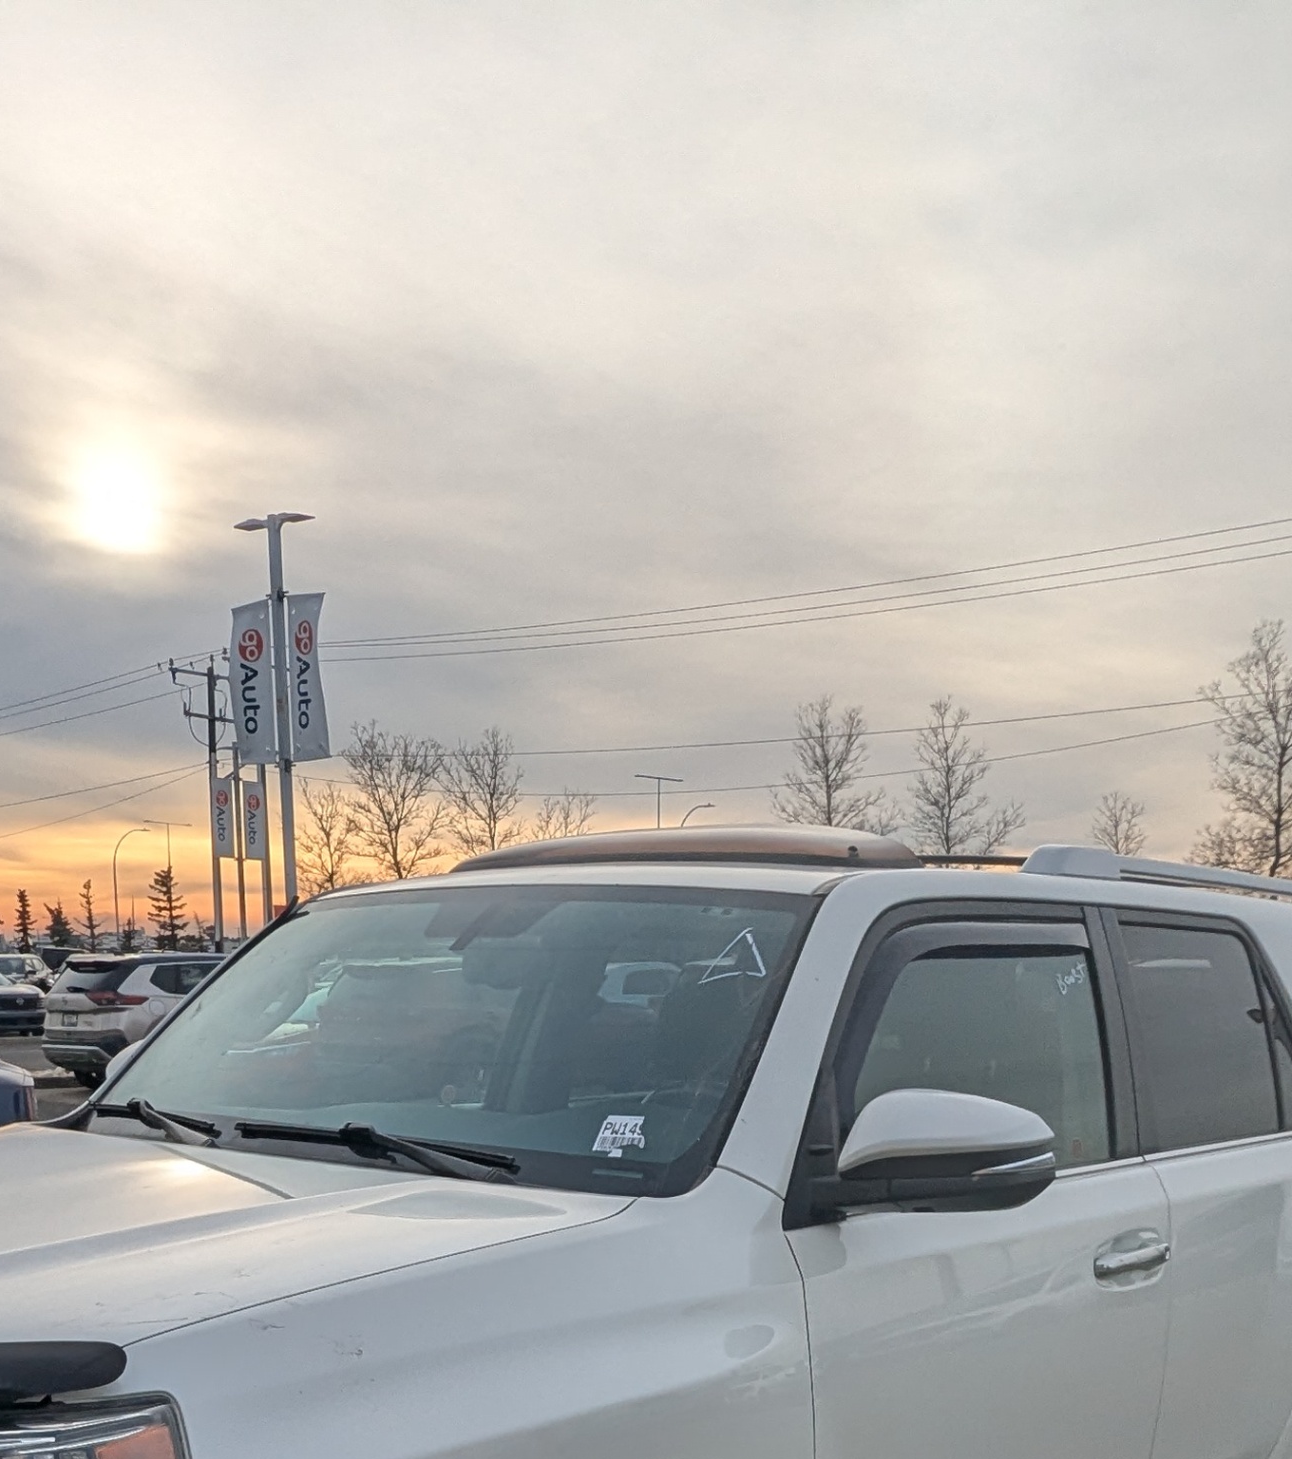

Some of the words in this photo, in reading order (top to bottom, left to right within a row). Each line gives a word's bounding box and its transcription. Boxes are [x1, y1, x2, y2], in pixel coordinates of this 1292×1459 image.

[240, 663, 260, 734] Auto
[296, 656, 311, 729] Auto
[216, 806, 226, 841] Auto
[248, 810, 257, 845] Auto
